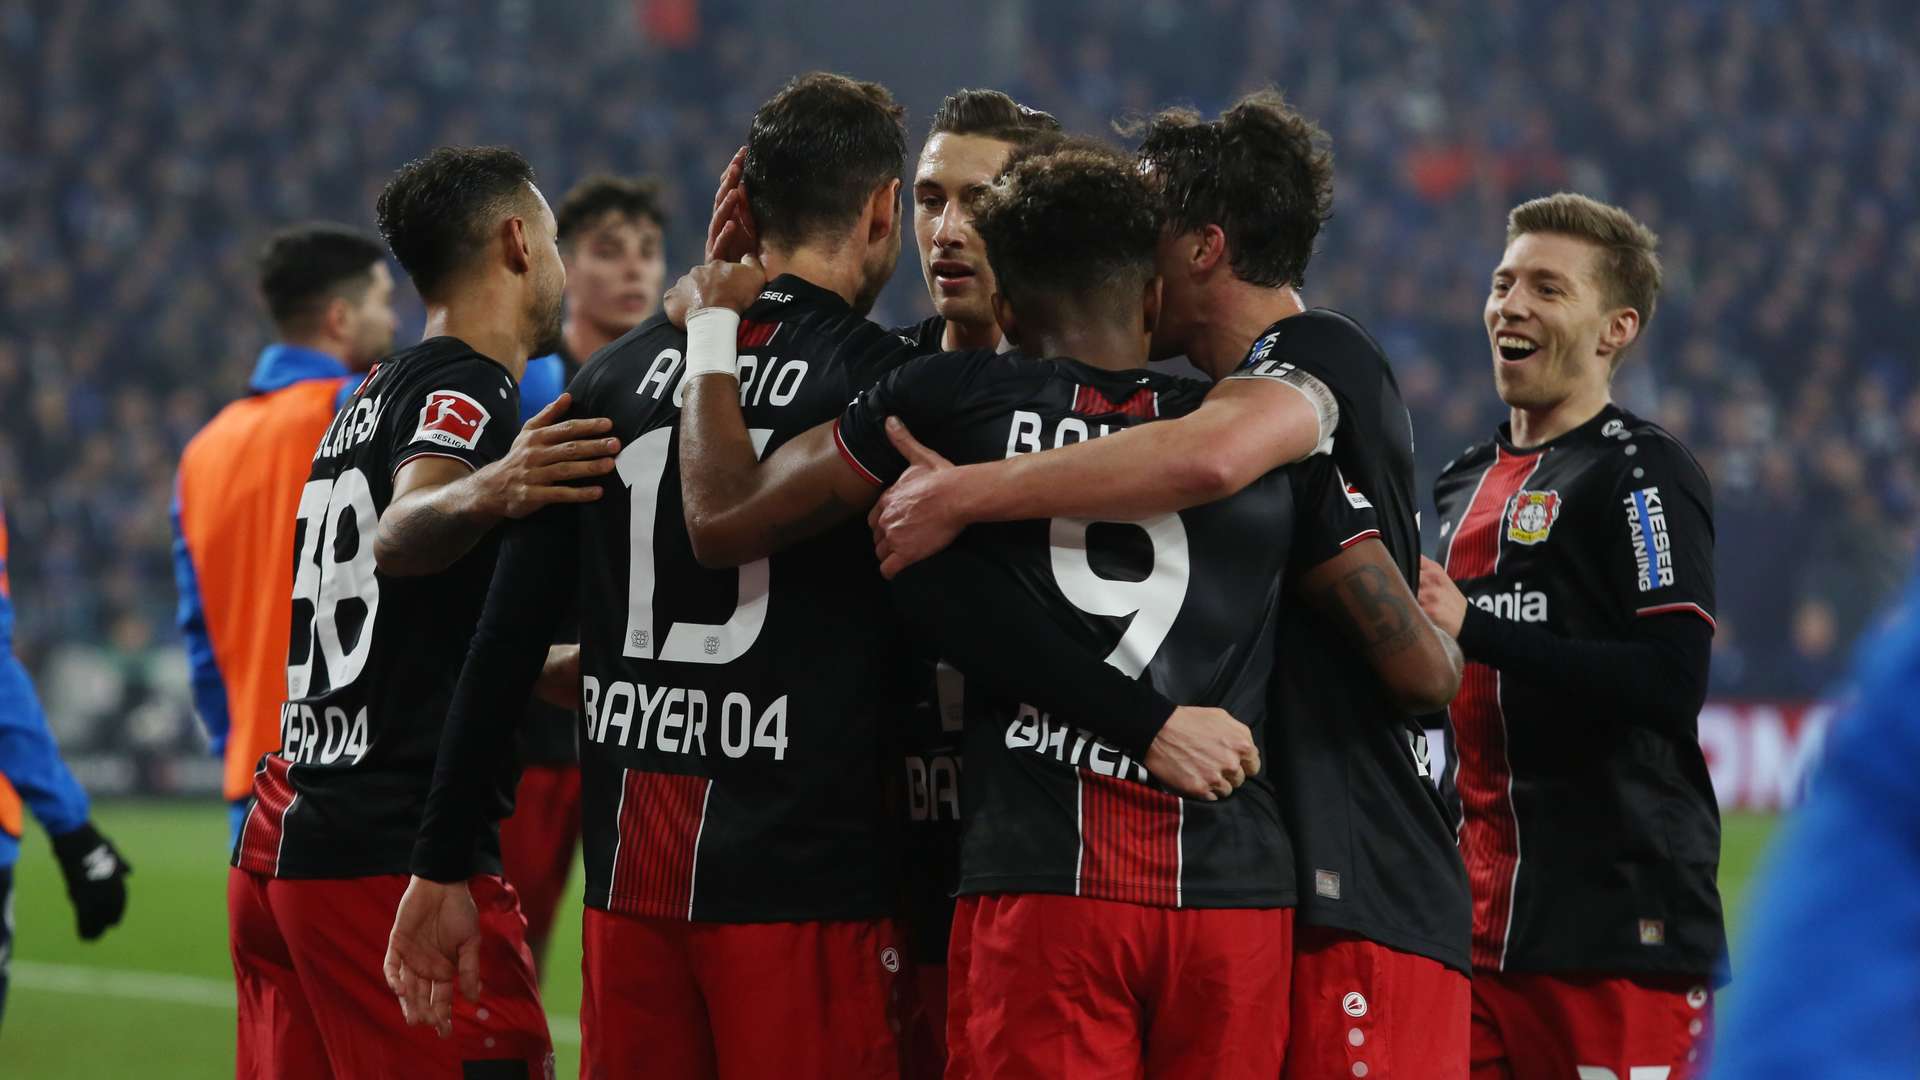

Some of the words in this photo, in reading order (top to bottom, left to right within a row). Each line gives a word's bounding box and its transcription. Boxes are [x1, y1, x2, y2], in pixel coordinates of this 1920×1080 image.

[759, 290, 794, 304] SELF
[1623, 491, 1651, 592] TRAINING
[1641, 486, 1675, 588] KIESER
[287, 467, 380, 701] 38
[1049, 511, 1190, 681] 9
[1468, 582, 1548, 622] enia
[583, 675, 709, 756] BAYER
[720, 691, 789, 761] 04
[905, 755, 963, 822] BA
